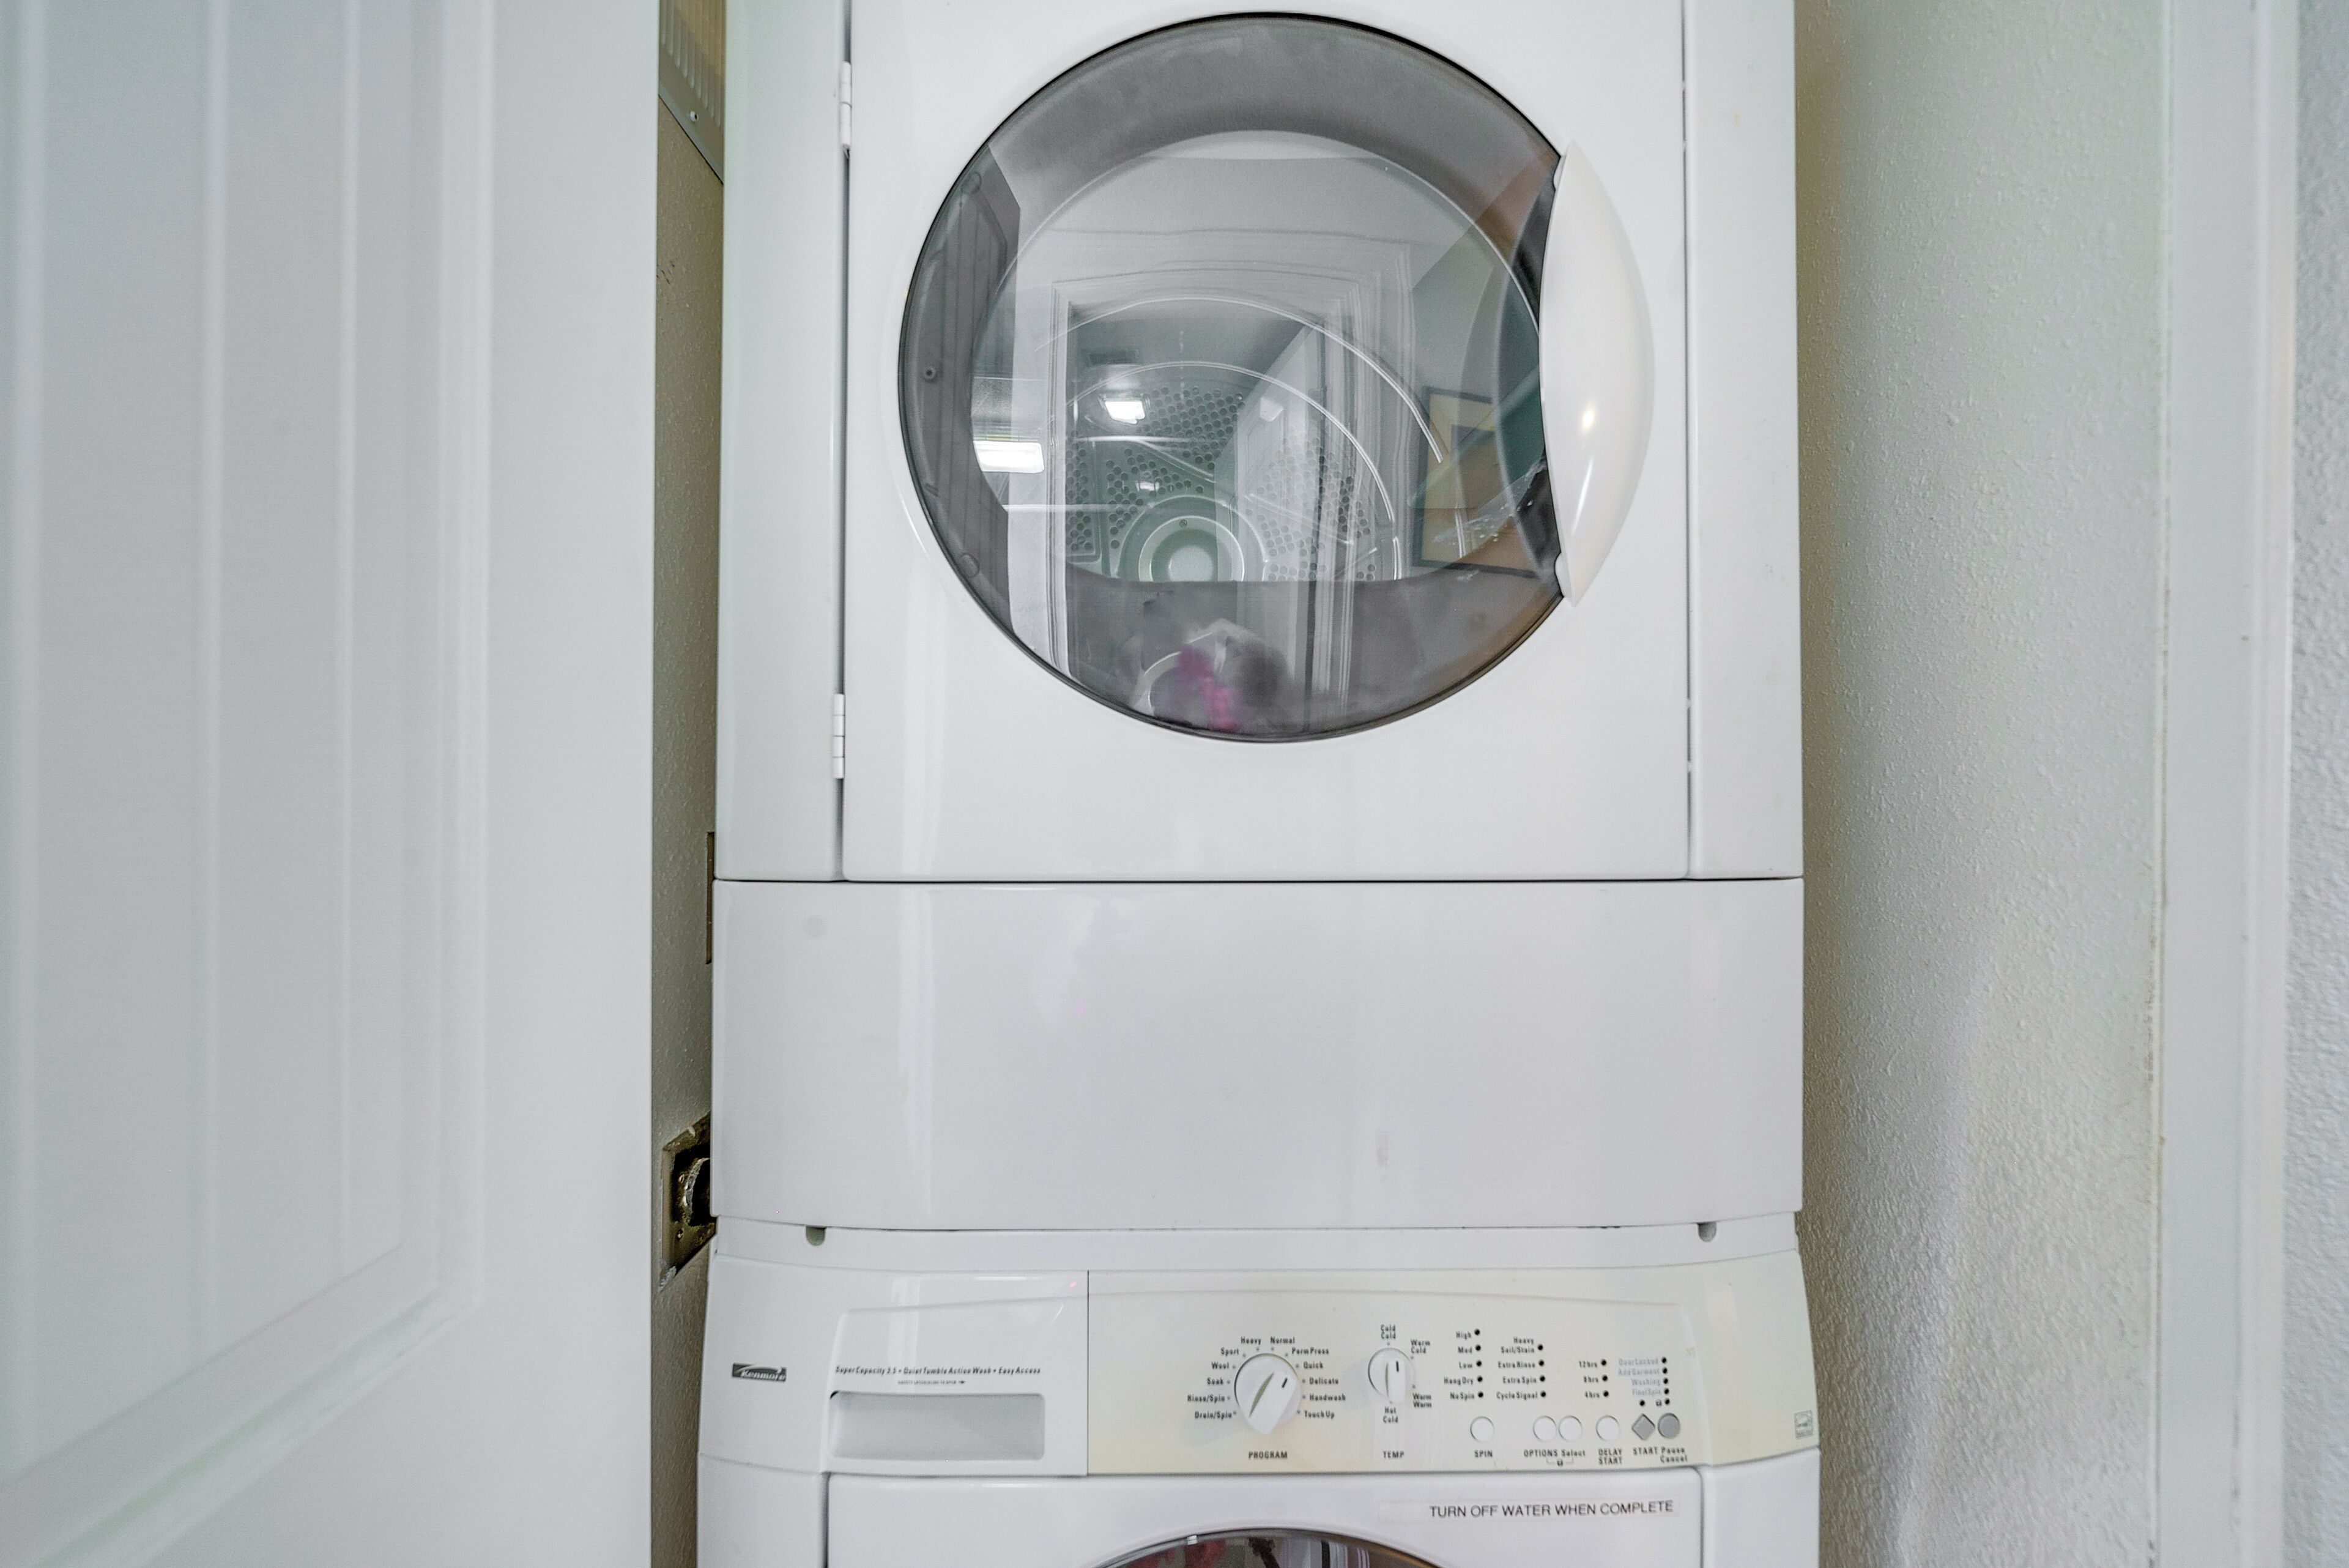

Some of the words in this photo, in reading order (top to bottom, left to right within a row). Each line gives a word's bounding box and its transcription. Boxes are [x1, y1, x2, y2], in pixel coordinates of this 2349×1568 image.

[1381, 1331, 1396, 1340] Cold
[1456, 1331, 1472, 1340] High
[1241, 1336, 1261, 1345] Heavy
[1270, 1336, 1295, 1345] Normal
[1513, 1336, 1534, 1345] Heavy
[1220, 1347, 1239, 1356] Sport
[1411, 1346, 1427, 1354] Cold
[1211, 1361, 1230, 1370] Wool
[1303, 1361, 1324, 1370] Quick
[740, 1370, 786, 1380] Kenmore
[1206, 1377, 1223, 1386] Soak
[1187, 1394, 1225, 1403] Rinse/Spin
[1412, 1392, 1432, 1401] Warm
[1195, 1410, 1233, 1420] Drain/Spin
[1382, 1415, 1398, 1424] Cold
[1249, 1451, 1288, 1460] PROGRAM
[1382, 1451, 1405, 1459] TEMP
[1474, 1450, 1493, 1458] SPIN
[1524, 1449, 1558, 1458] OPTIONS
[1561, 1449, 1586, 1457] Select
[1598, 1448, 1622, 1457] DELAY
[1633, 1446, 1658, 1456] START
[1661, 1446, 1686, 1455] Pause
[1598, 1456, 1622, 1465] START
[1660, 1454, 1688, 1463] Cancel
[1430, 1506, 1466, 1518] TURN
[1471, 1505, 1498, 1518] OFF
[1502, 1504, 1551, 1517] WATER
[1554, 1503, 1596, 1516] WHEN
[1600, 1499, 1673, 1515] COMPLETE
